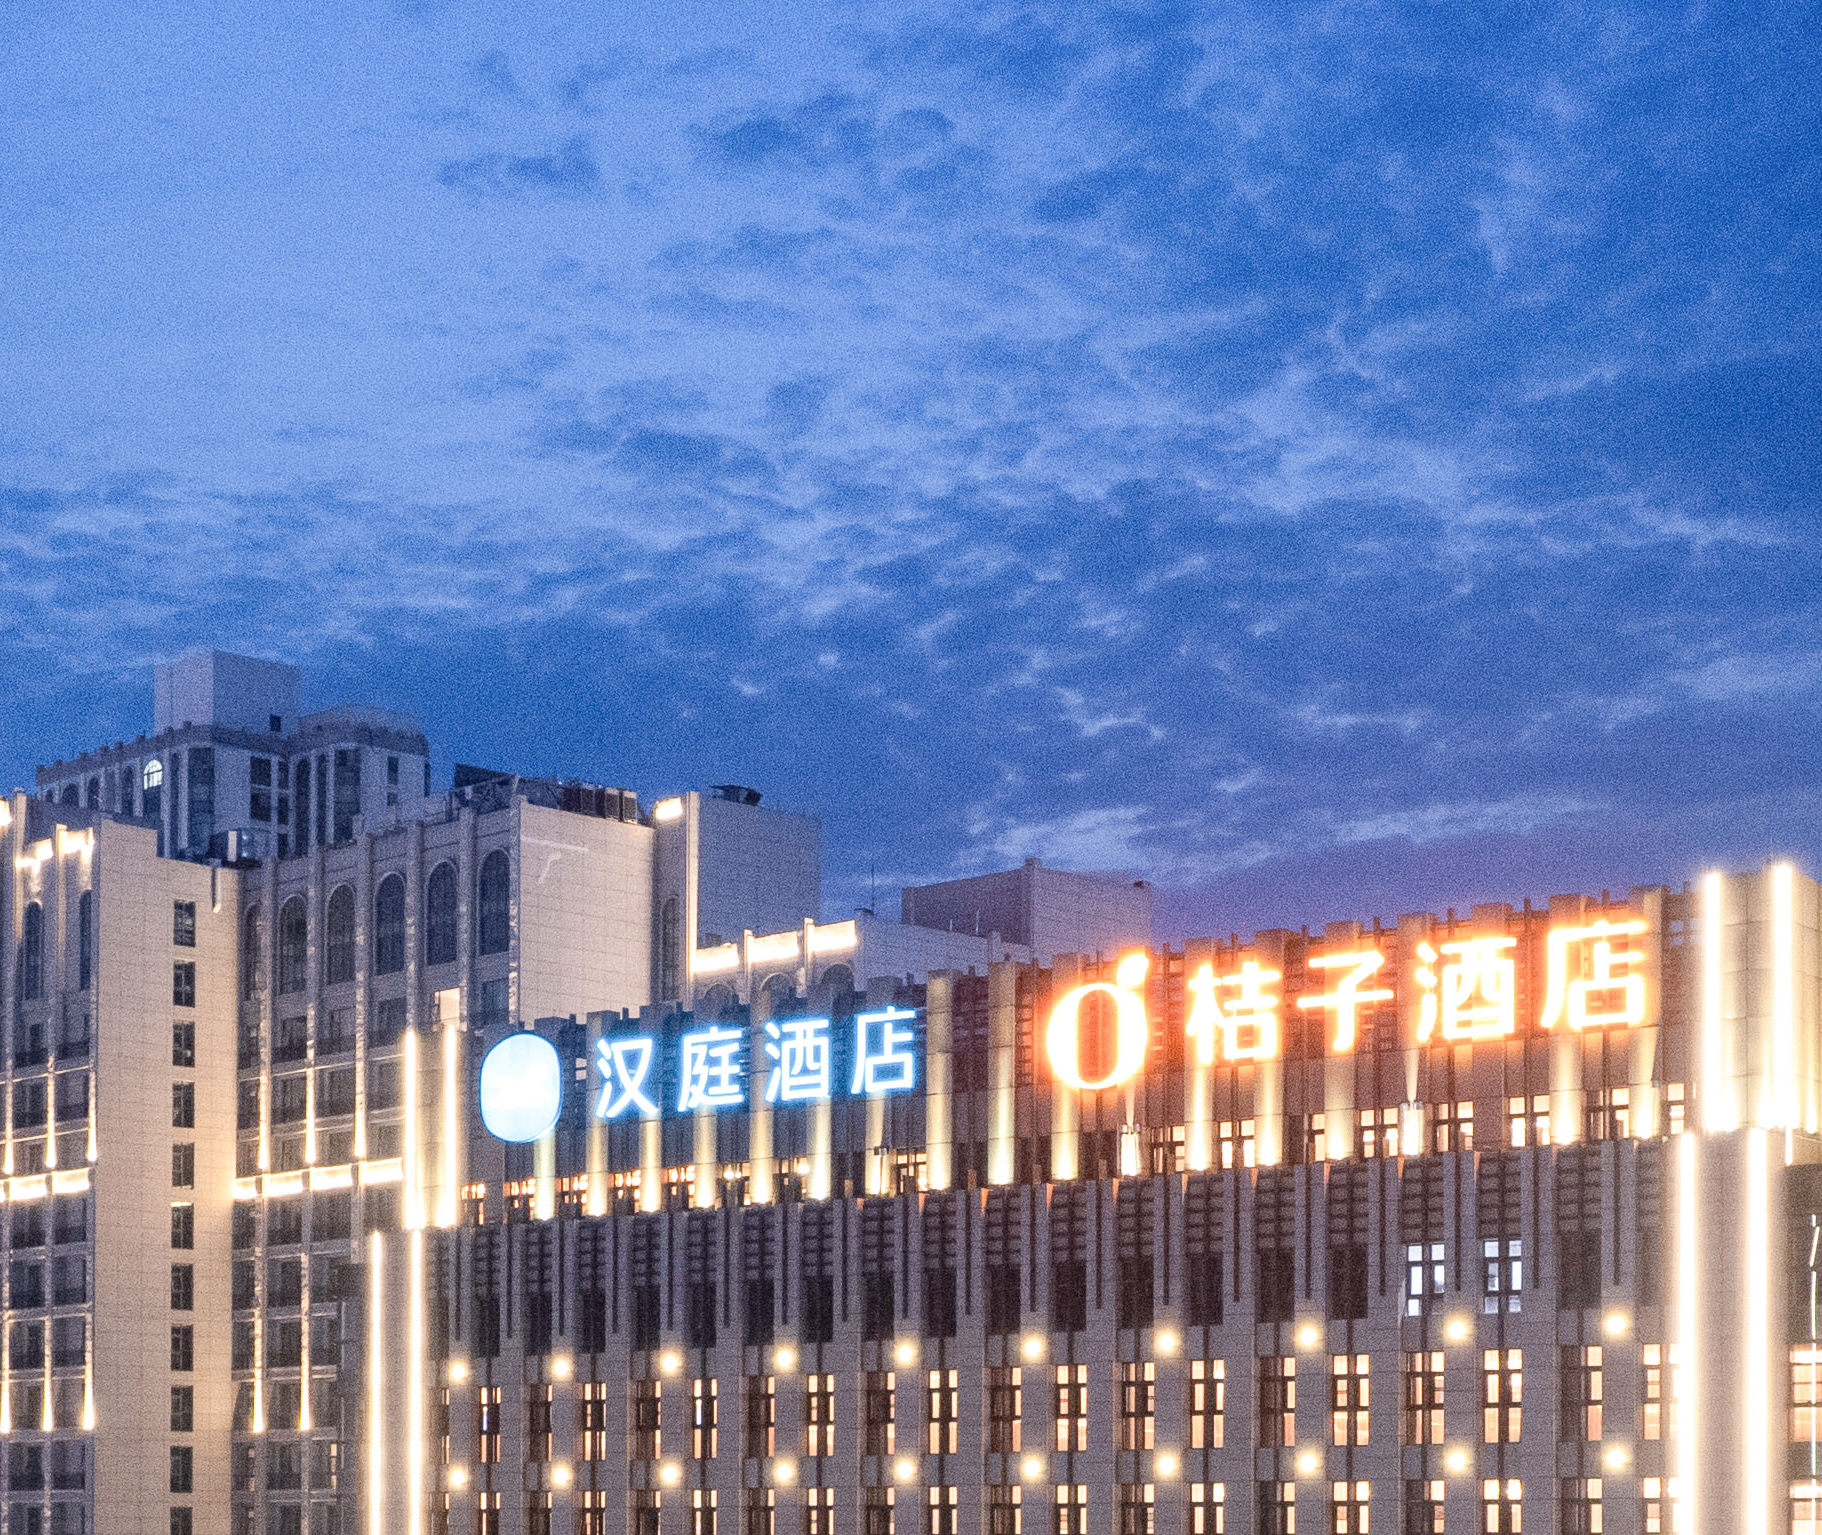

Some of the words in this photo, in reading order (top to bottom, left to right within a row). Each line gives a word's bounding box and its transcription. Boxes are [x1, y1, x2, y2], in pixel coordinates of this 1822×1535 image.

[1185, 920, 1648, 1068] 桔子酒店
[594, 1005, 918, 1120] 汉庭酒店
